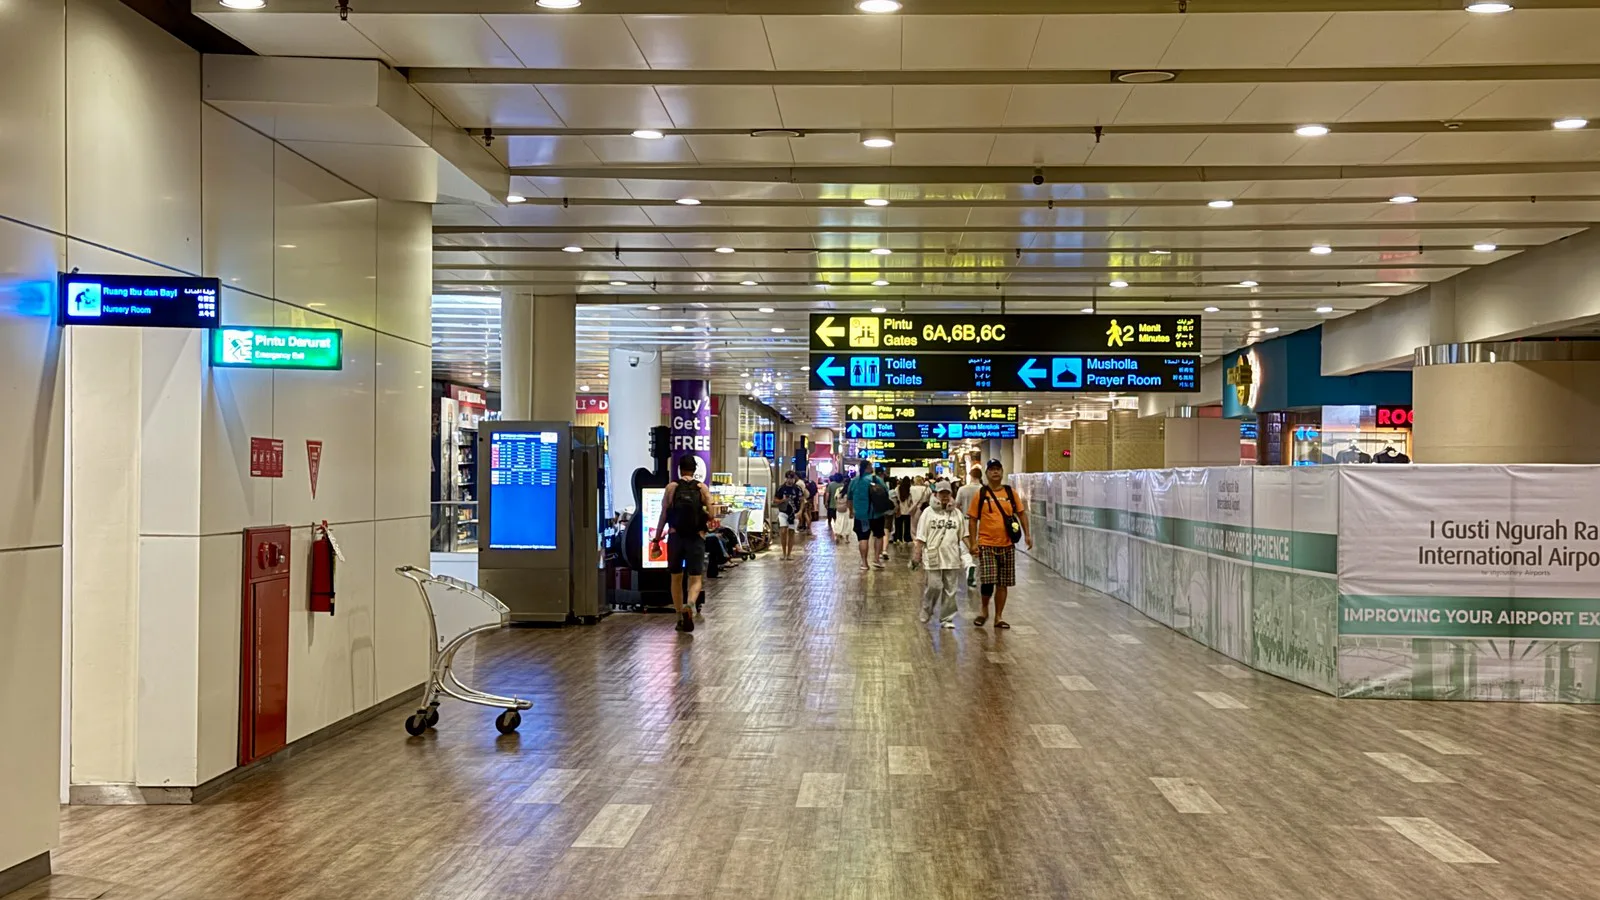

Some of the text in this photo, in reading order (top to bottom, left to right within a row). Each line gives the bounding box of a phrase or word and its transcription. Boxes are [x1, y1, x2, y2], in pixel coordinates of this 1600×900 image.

[103, 287, 128, 297] Ruang
[103, 305, 151, 314] Nursery Room
[884, 318, 913, 330] Pintu
[883, 324, 1006, 346] Gates 6A,6B,6C
[1122, 324, 1161, 342] 2 Menit
[1139, 334, 1170, 343] Minutes
[255, 335, 331, 349] Pintu Darurat
[885, 358, 916, 369] Toilet
[1087, 358, 1138, 370] Musholla
[885, 374, 922, 385] Toilets
[1087, 374, 1125, 387] Prayer
[1127, 374, 1161, 385] Room
[674, 395, 702, 414] Buy
[673, 416, 701, 430] Get
[674, 435, 711, 451] FREE
[1430, 518, 1598, 545] I Gusti Ngurah Ra
[1246, 532, 1290, 561] EXPERIENCE
[1418, 544, 1600, 572] International Airpo
[1344, 607, 1600, 626] IMPROVING YOUR AIRPORT EX
